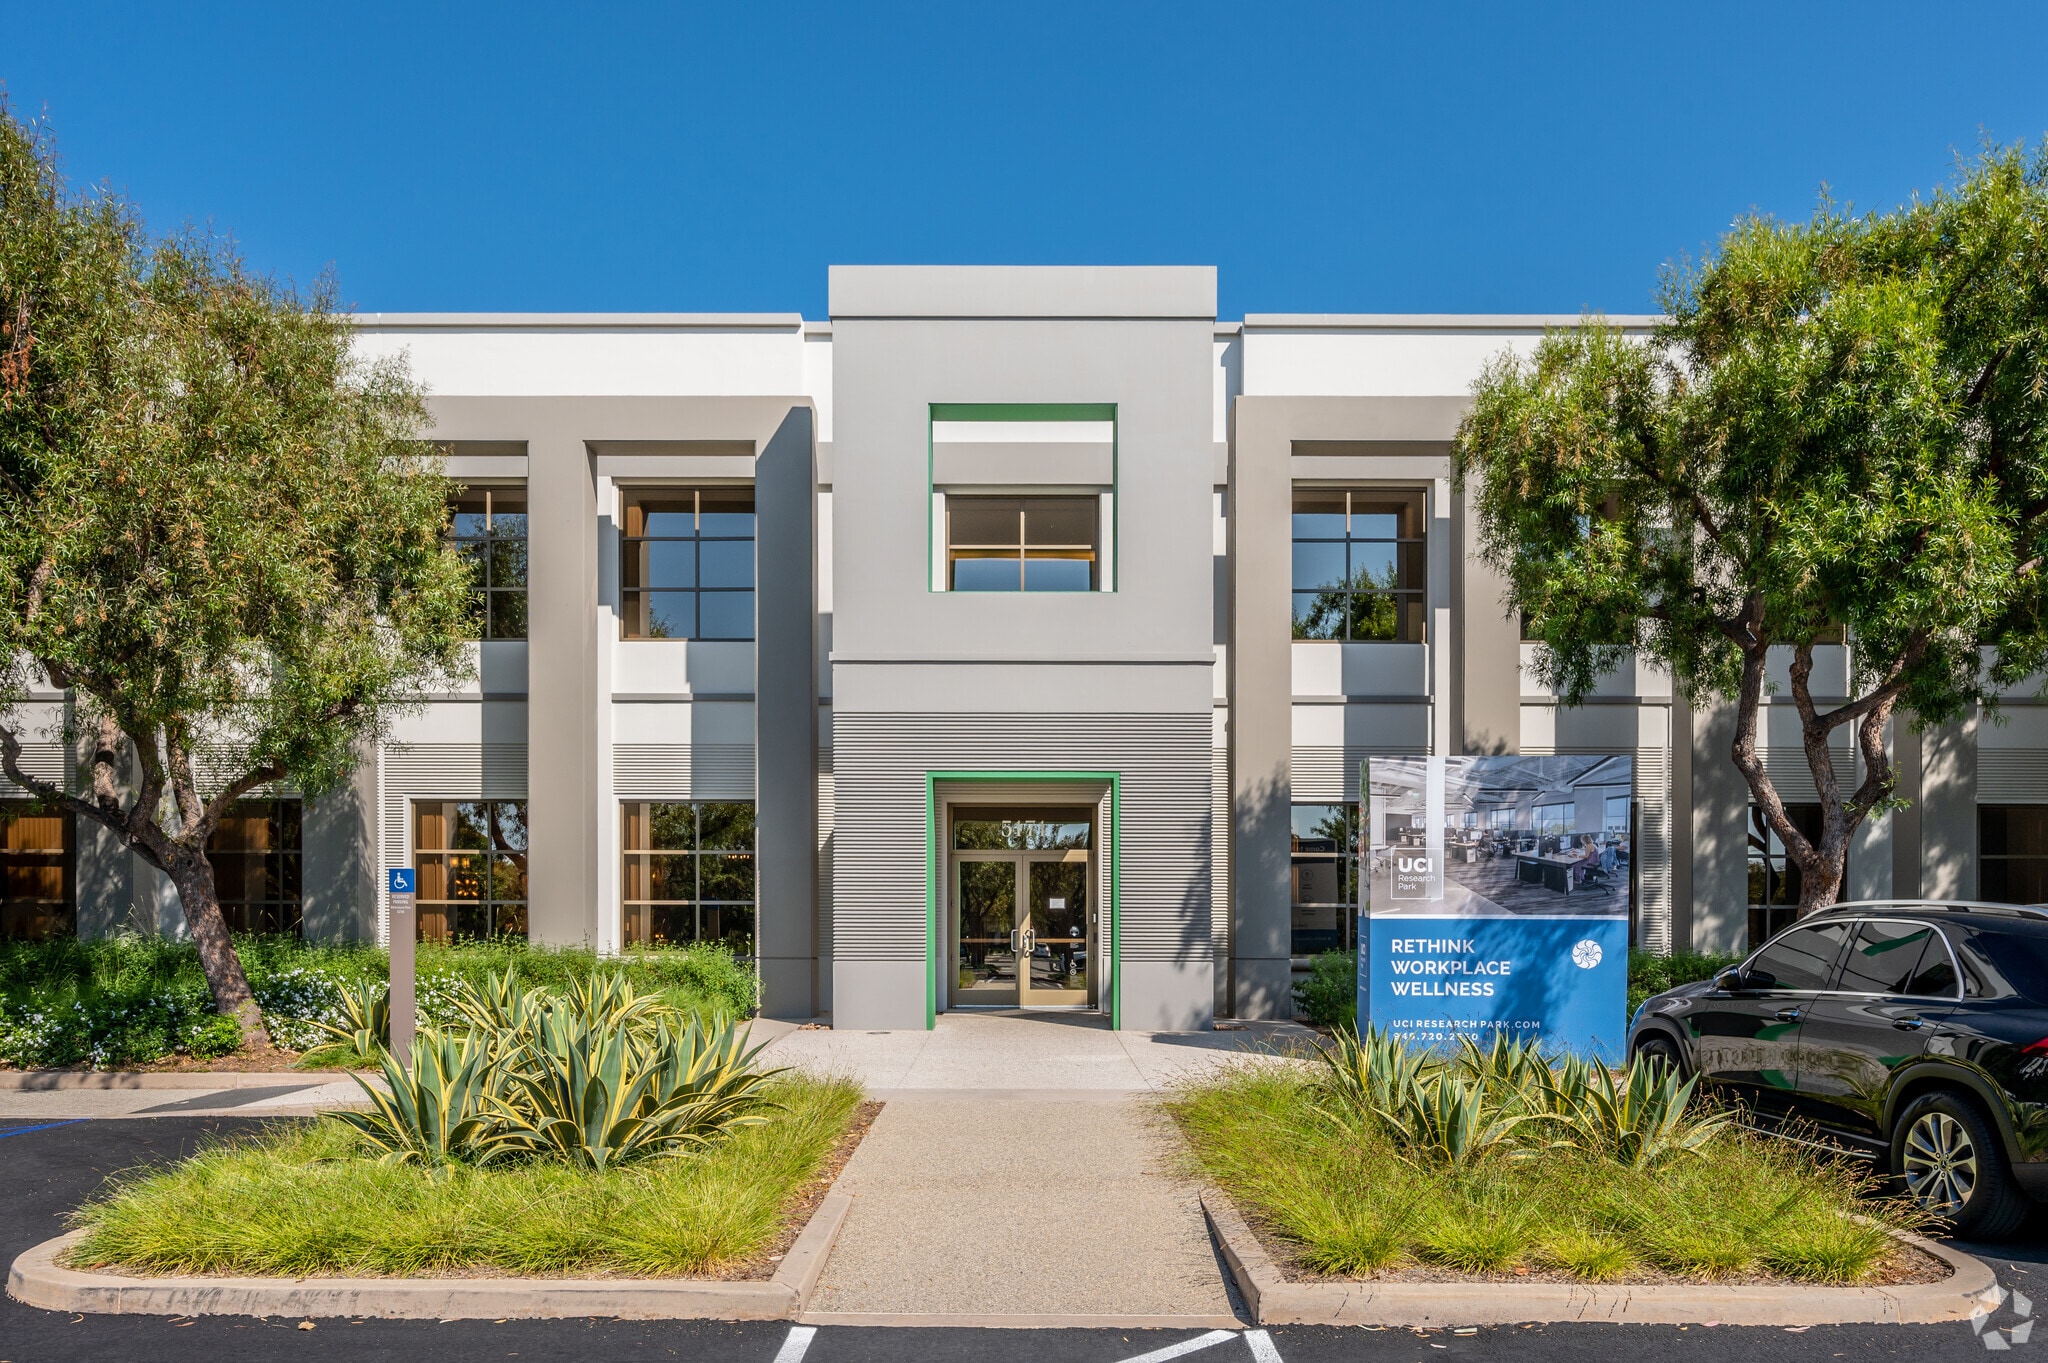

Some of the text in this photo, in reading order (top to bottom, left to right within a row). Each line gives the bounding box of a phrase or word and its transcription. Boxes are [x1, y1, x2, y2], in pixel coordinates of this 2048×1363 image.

[1001, 820, 1044, 837] 5171
[1398, 857, 1433, 873] UCI
[1398, 874, 1436, 882] Research
[1398, 882, 1417, 890] Park
[1391, 939, 1475, 953] RETHINK
[1390, 960, 1511, 975] WORKPLACE
[1390, 981, 1495, 996] WELLNESS
